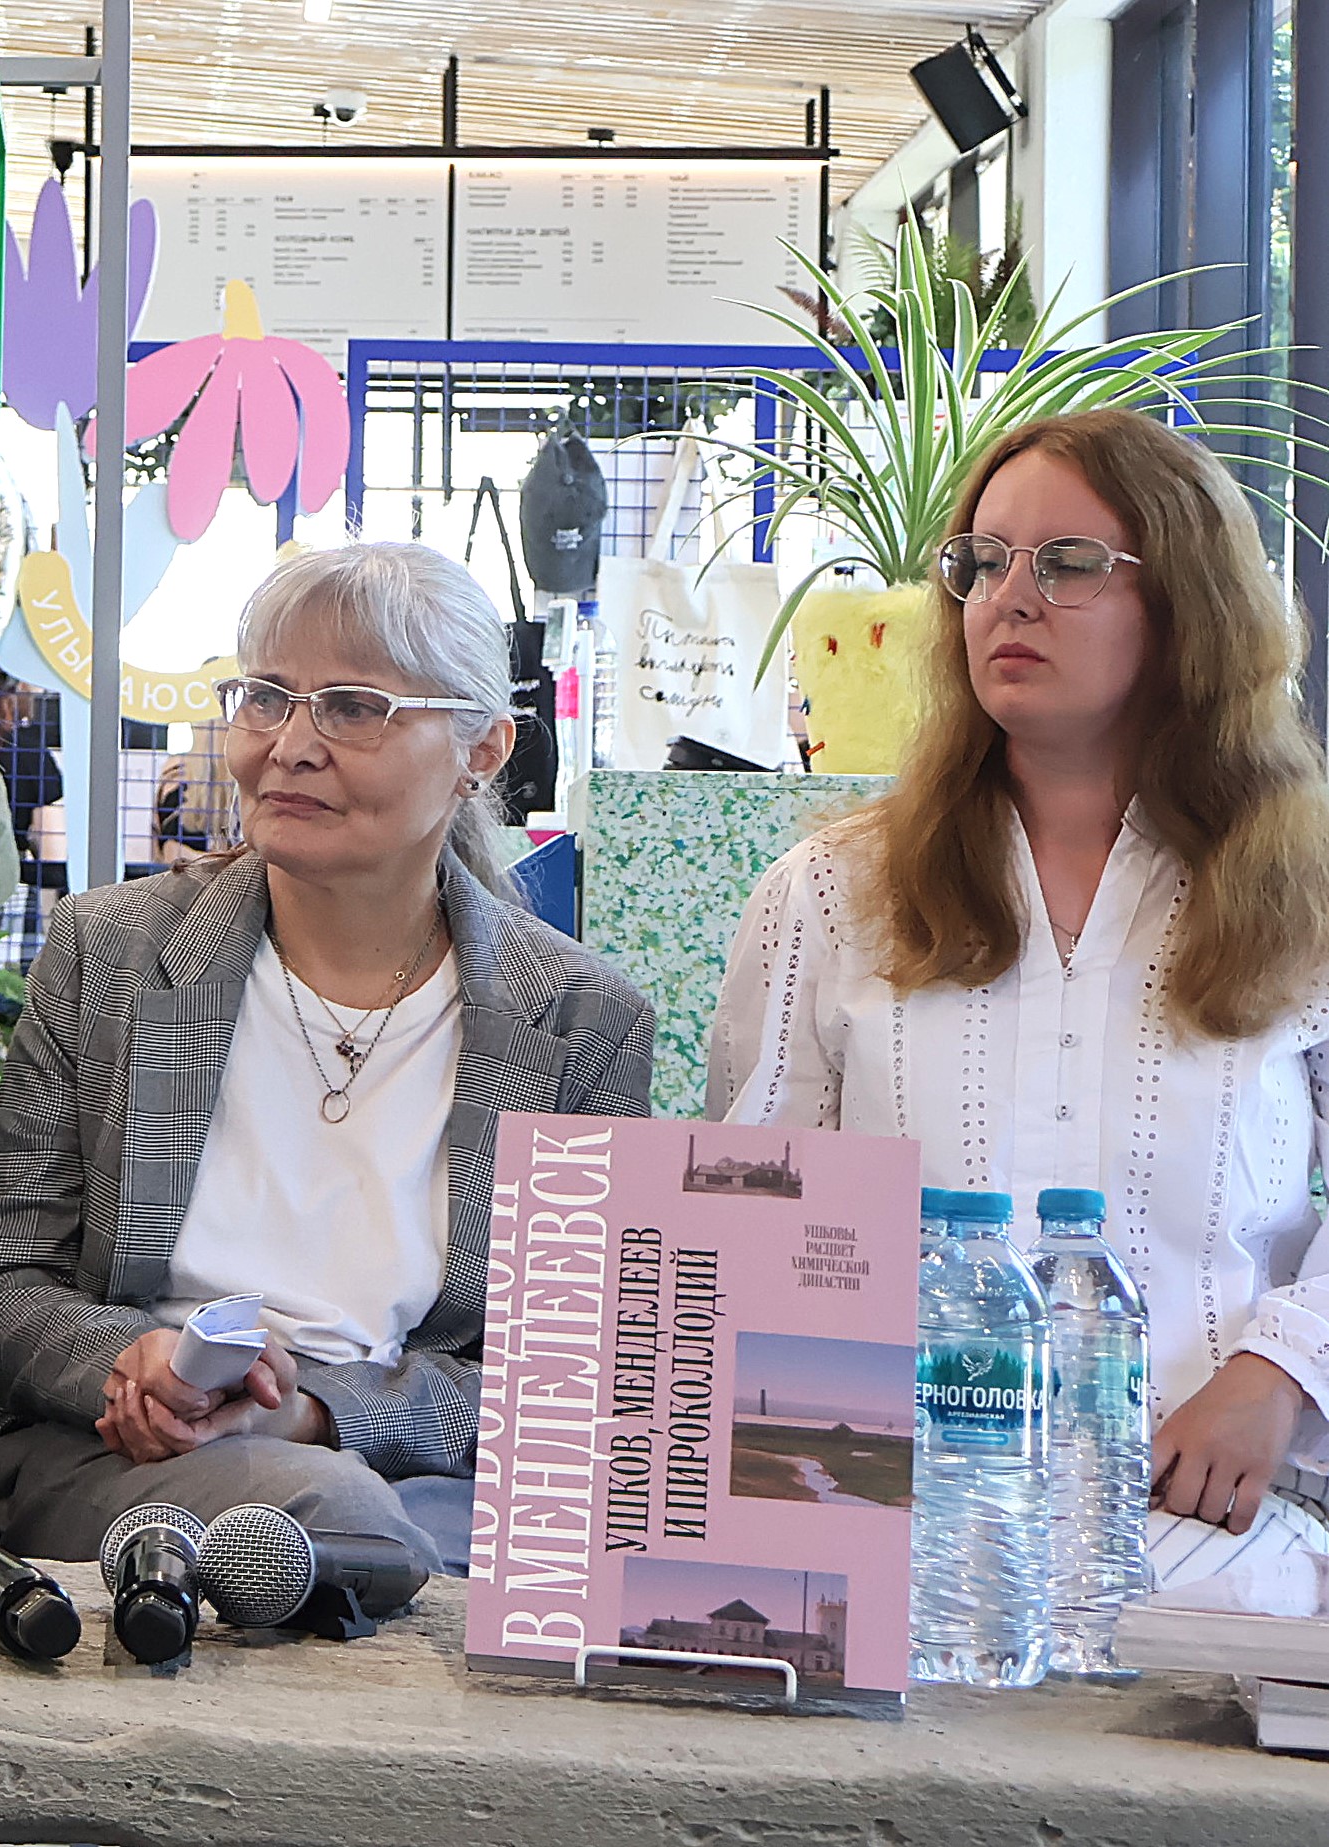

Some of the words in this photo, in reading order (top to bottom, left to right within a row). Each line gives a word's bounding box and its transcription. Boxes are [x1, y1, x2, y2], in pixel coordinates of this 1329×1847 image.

[31, 589, 218, 712] УЛЫАЮС
[791, 1256, 869, 1276] ХИМИЧЕСКОЙ
[797, 1273, 860, 1291] ДИНАСТИИ
[504, 1126, 621, 1600] МЕНДЕЛЕЕВСК
[612, 1227, 669, 1420] МЕНДЕЛЕЕВ
[665, 1247, 727, 1512] ПИРОКОЛЛОДИЙ
[915, 1382, 1048, 1411] ЕРНОГОЛОВКА
[605, 1427, 664, 1552] УШКОВ,
[664, 1516, 706, 1541] И
[501, 1610, 585, 1648] В
